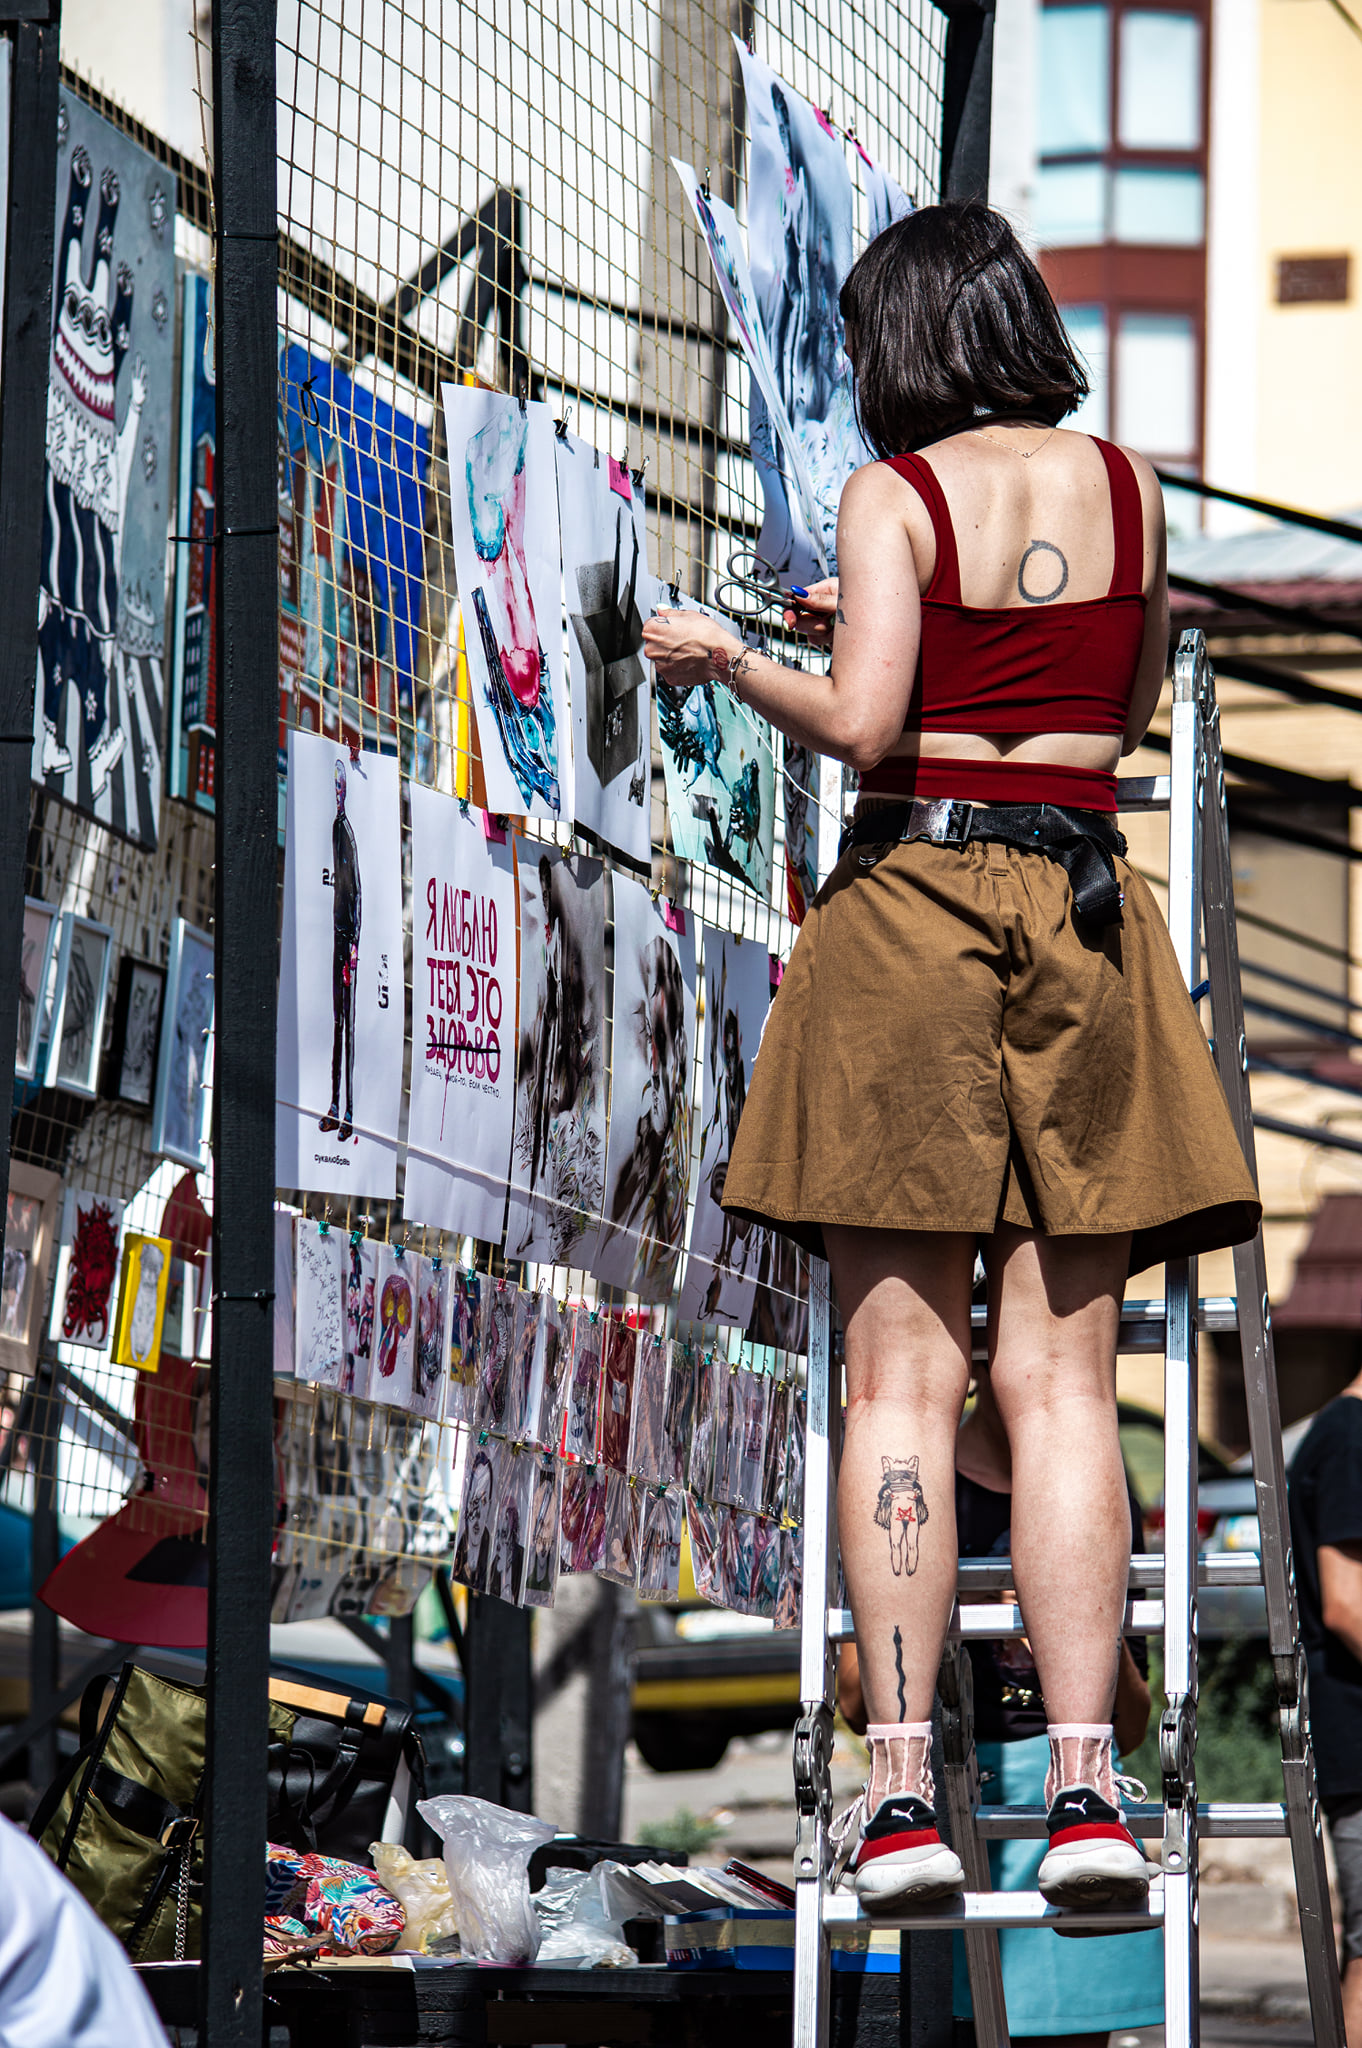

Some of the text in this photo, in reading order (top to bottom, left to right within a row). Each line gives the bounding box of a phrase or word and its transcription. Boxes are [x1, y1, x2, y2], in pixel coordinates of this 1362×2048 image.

[426, 877, 498, 967] Я ЛЮБЛЮ
[426, 957, 464, 1020] ТЕБЯ,
[466, 964, 502, 1029] ЭТО
